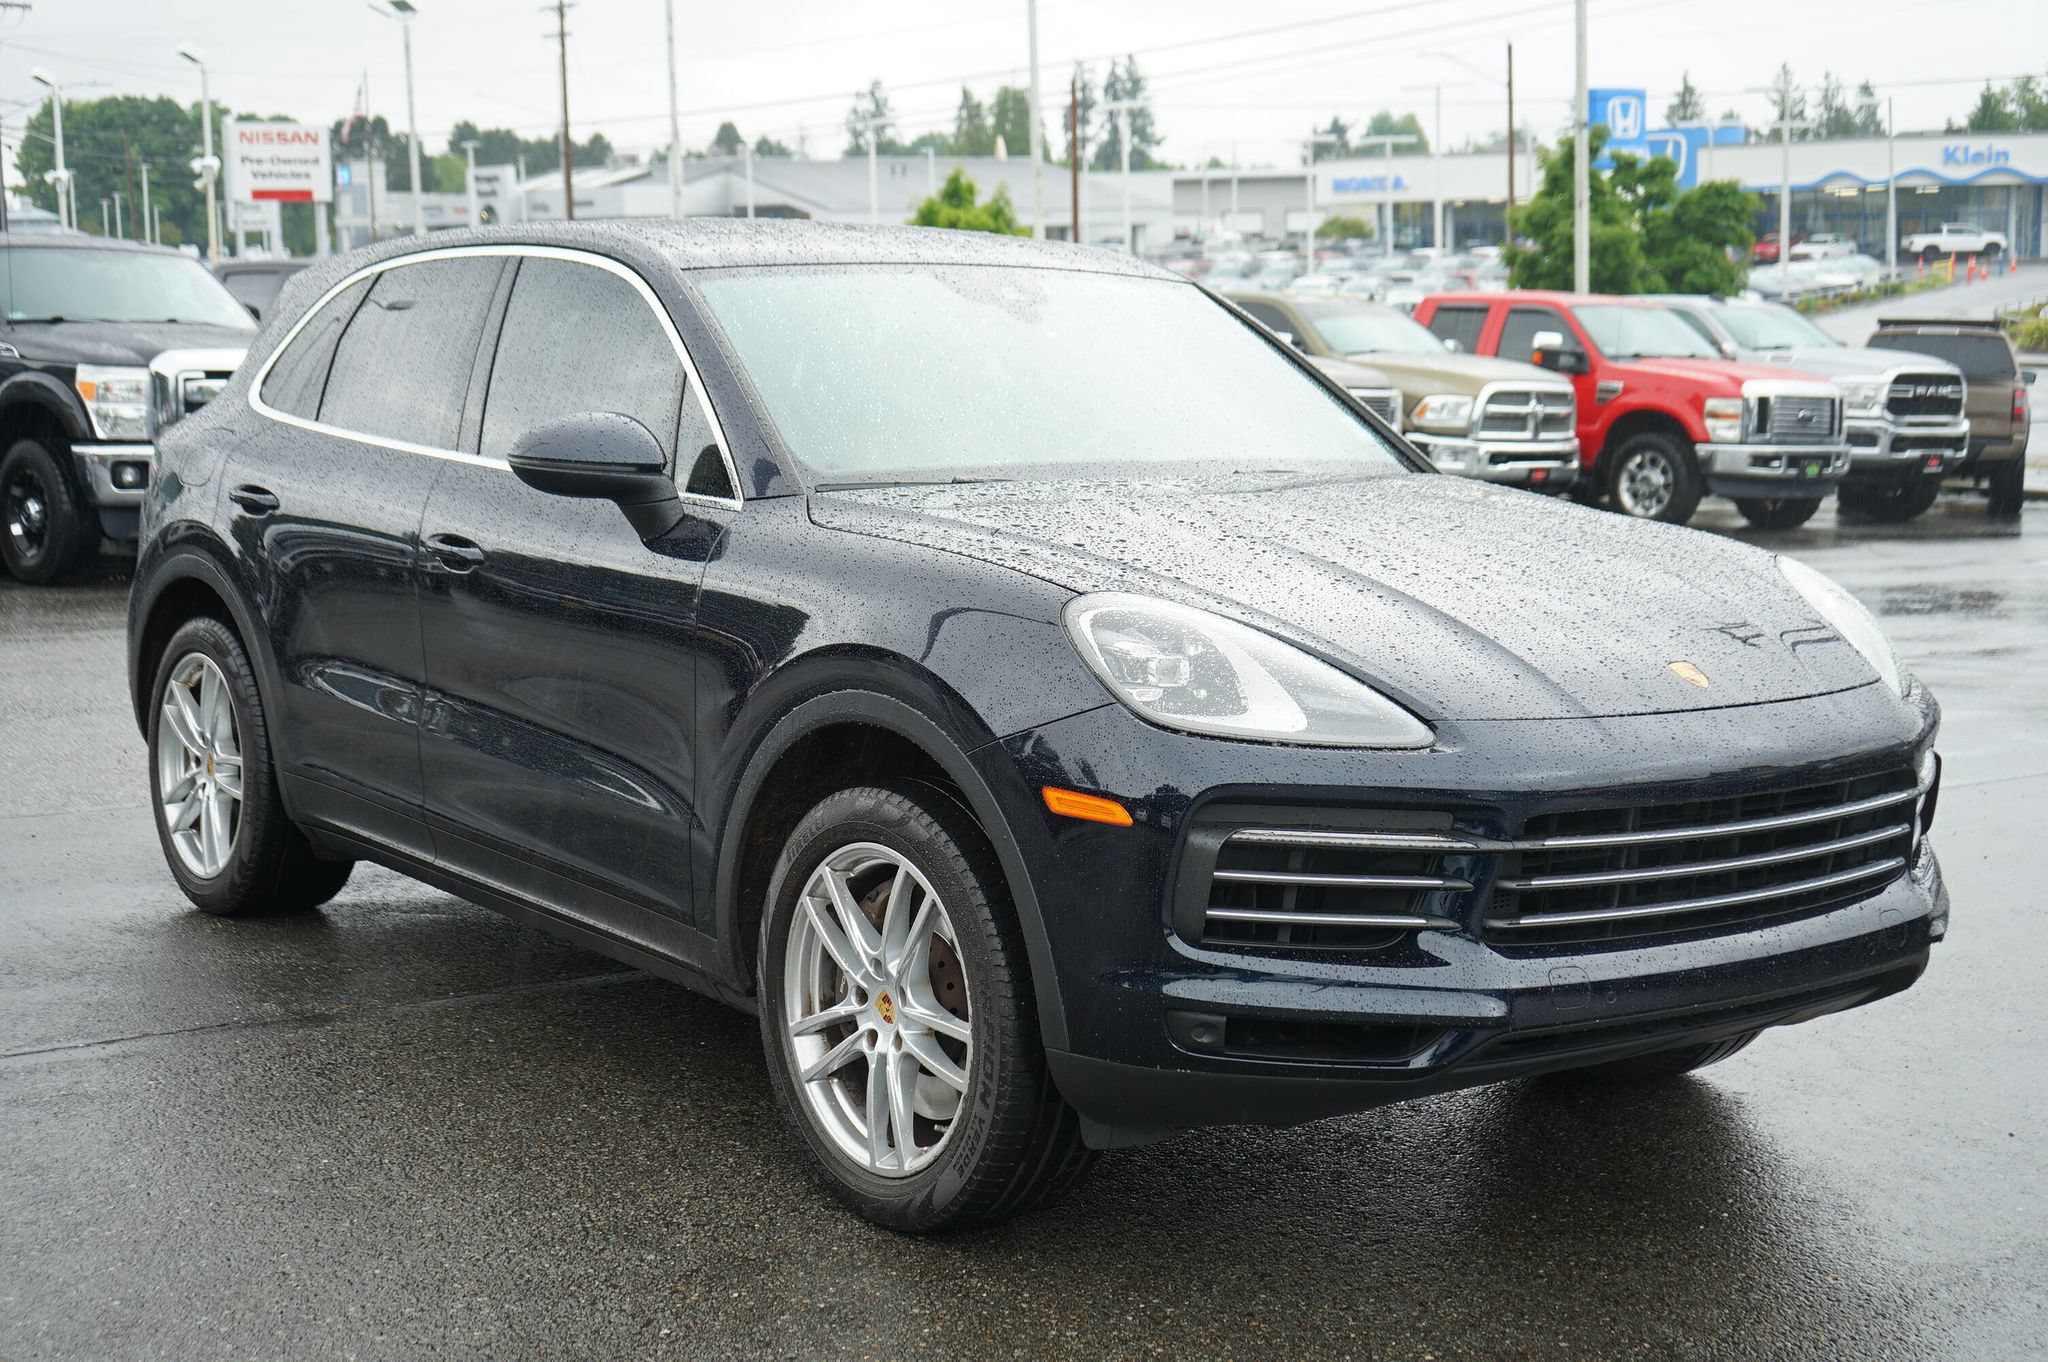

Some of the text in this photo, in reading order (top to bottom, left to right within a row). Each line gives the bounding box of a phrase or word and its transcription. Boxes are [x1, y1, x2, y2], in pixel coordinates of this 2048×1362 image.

[239, 130, 319, 144] NISSAN
[1943, 144, 2010, 166] Klein
[1915, 385, 1953, 397] RAM
